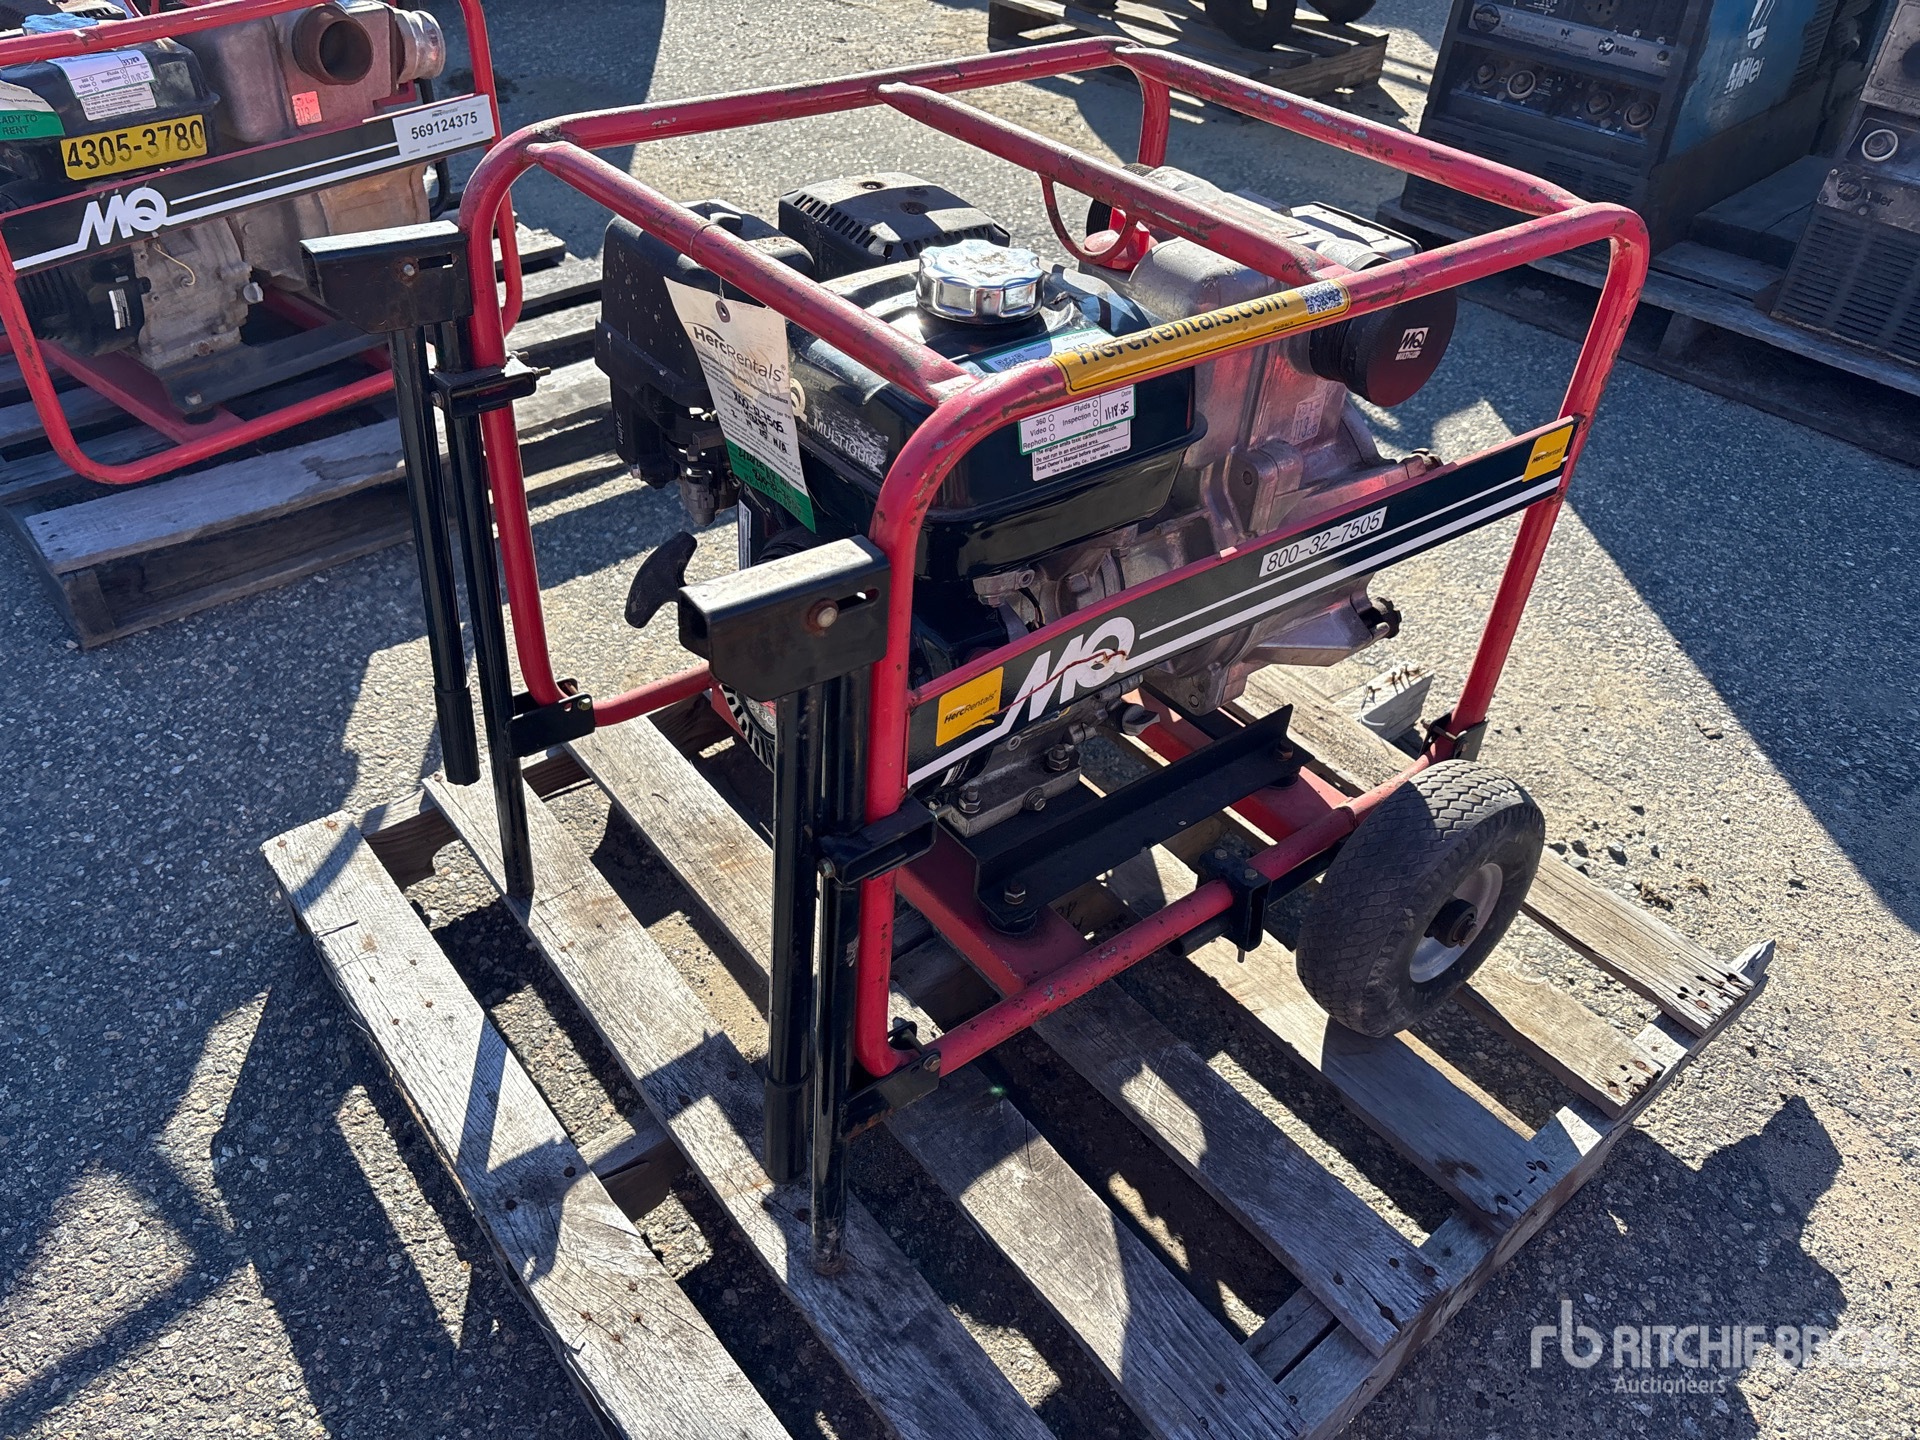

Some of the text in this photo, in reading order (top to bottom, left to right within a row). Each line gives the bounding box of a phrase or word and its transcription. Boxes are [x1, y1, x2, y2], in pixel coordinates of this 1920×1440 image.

[1615, 45, 1637, 58] Miller
[1724, 57, 1765, 94] Miller
[0, 113, 38, 124] ADY TO
[3, 125, 29, 135] RENT
[411, 111, 478, 140] 569124375
[67, 120, 204, 170] 4305-3780
[79, 187, 168, 250] MQ
[1076, 294, 1289, 366] HercRentals.com
[1400, 331, 1425, 350] MQ
[1030, 412, 1091, 436] Video Inspection
[1036, 402, 1090, 426] 360 Fluids
[1023, 437, 1047, 449] Rephoto
[1045, 444, 1058, 452] engine
[1083, 432, 1097, 440] carbon
[1064, 454, 1078, 462] Manual
[1079, 449, 1091, 457] before
[1266, 510, 1382, 573] 800-32-7505
[1001, 617, 1135, 732] MQ
[943, 690, 997, 724] HercRentals
